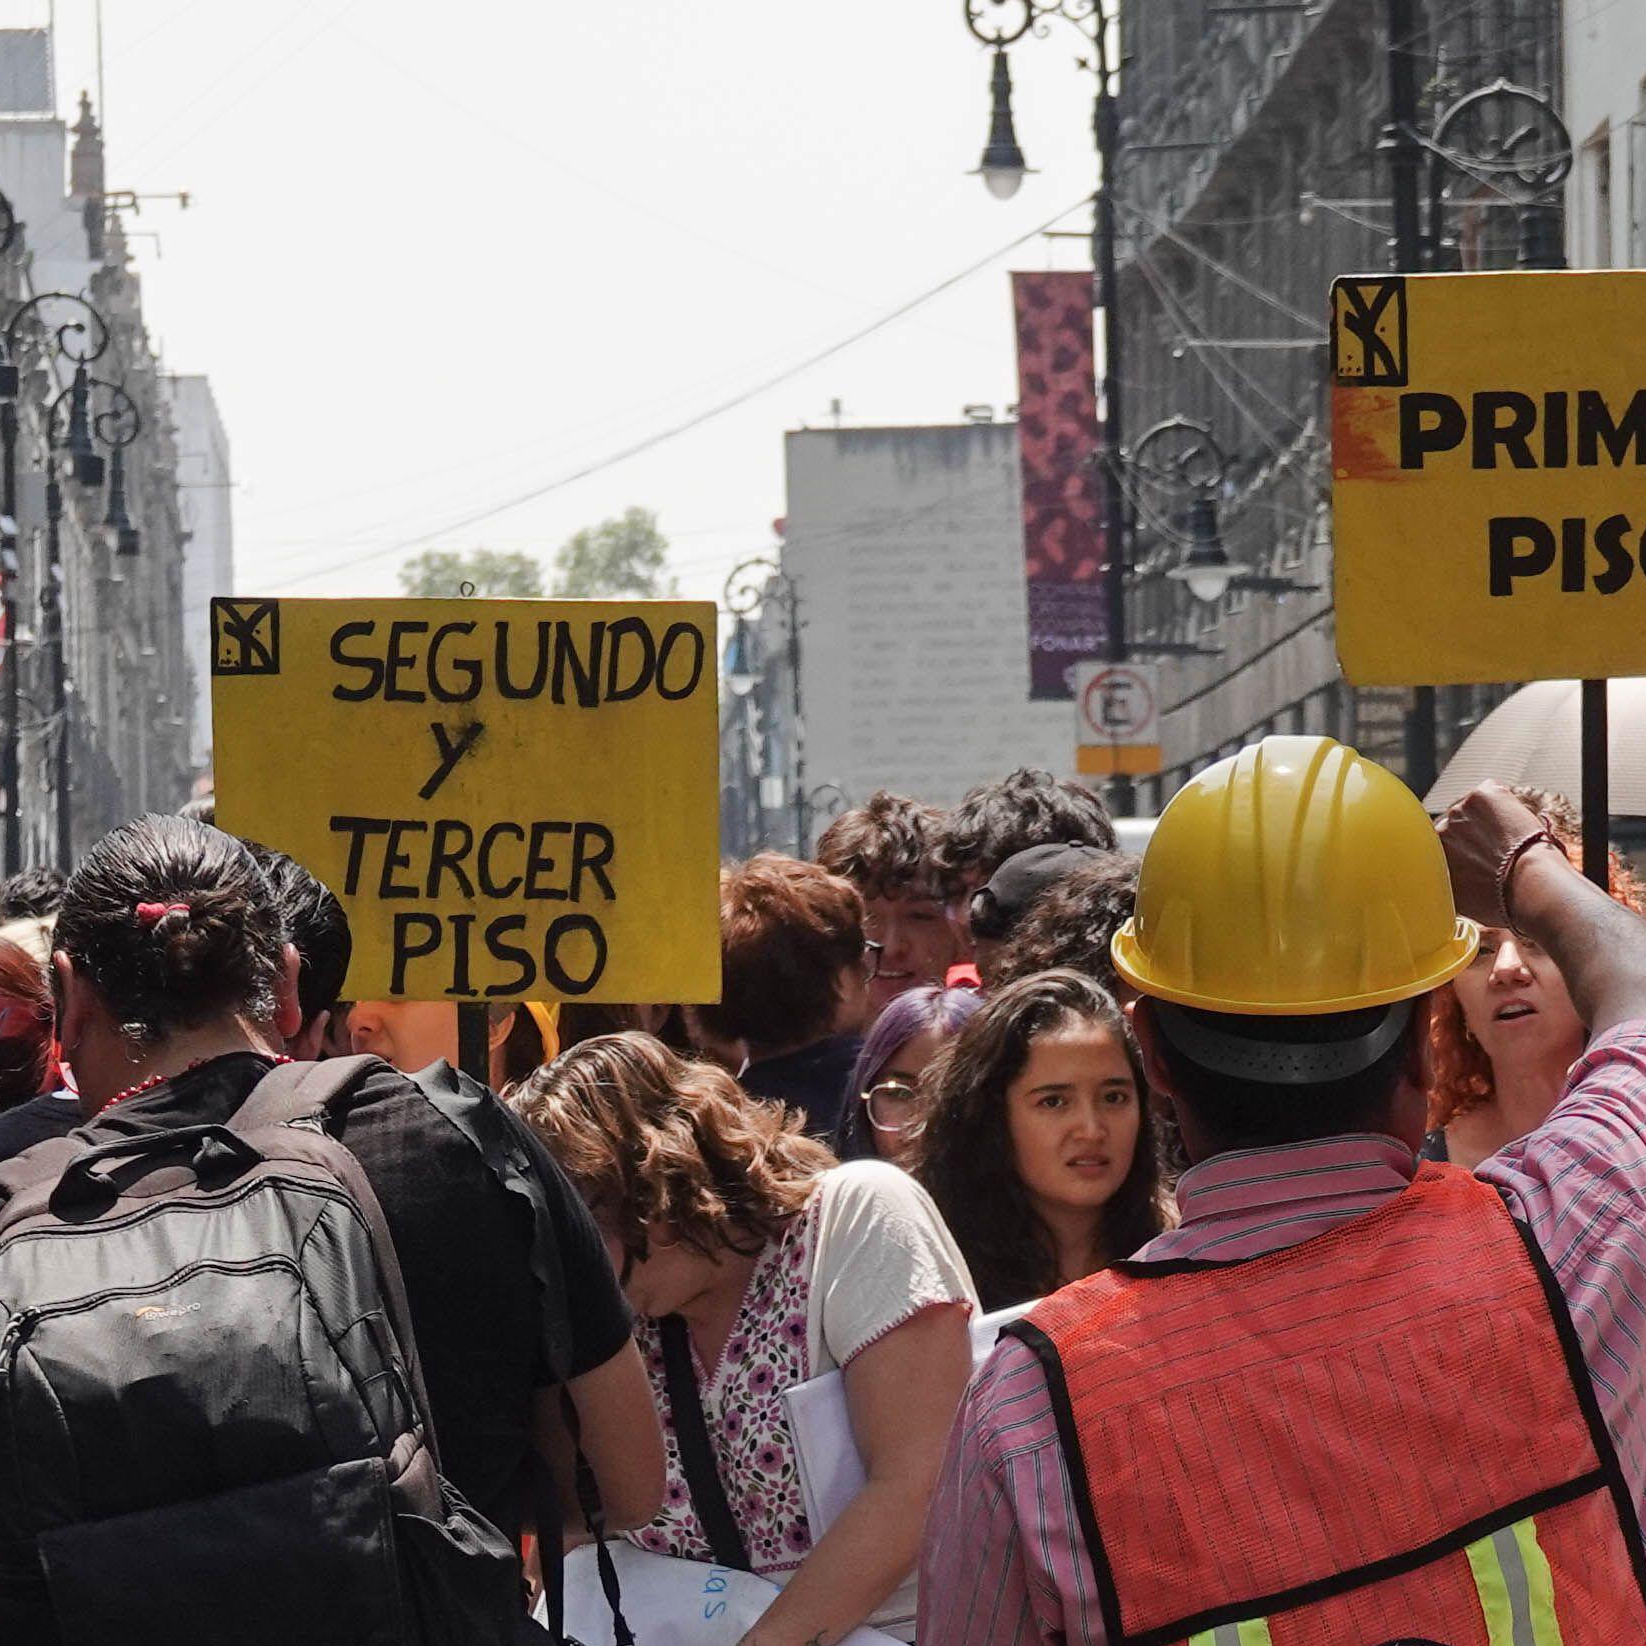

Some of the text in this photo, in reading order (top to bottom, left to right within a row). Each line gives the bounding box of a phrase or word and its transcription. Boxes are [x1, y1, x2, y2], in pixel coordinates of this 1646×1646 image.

[330, 617, 704, 707] SEGUNDO
[418, 722, 484, 799] Y
[329, 816, 616, 901] TERCER
[390, 912, 608, 997] PISO
